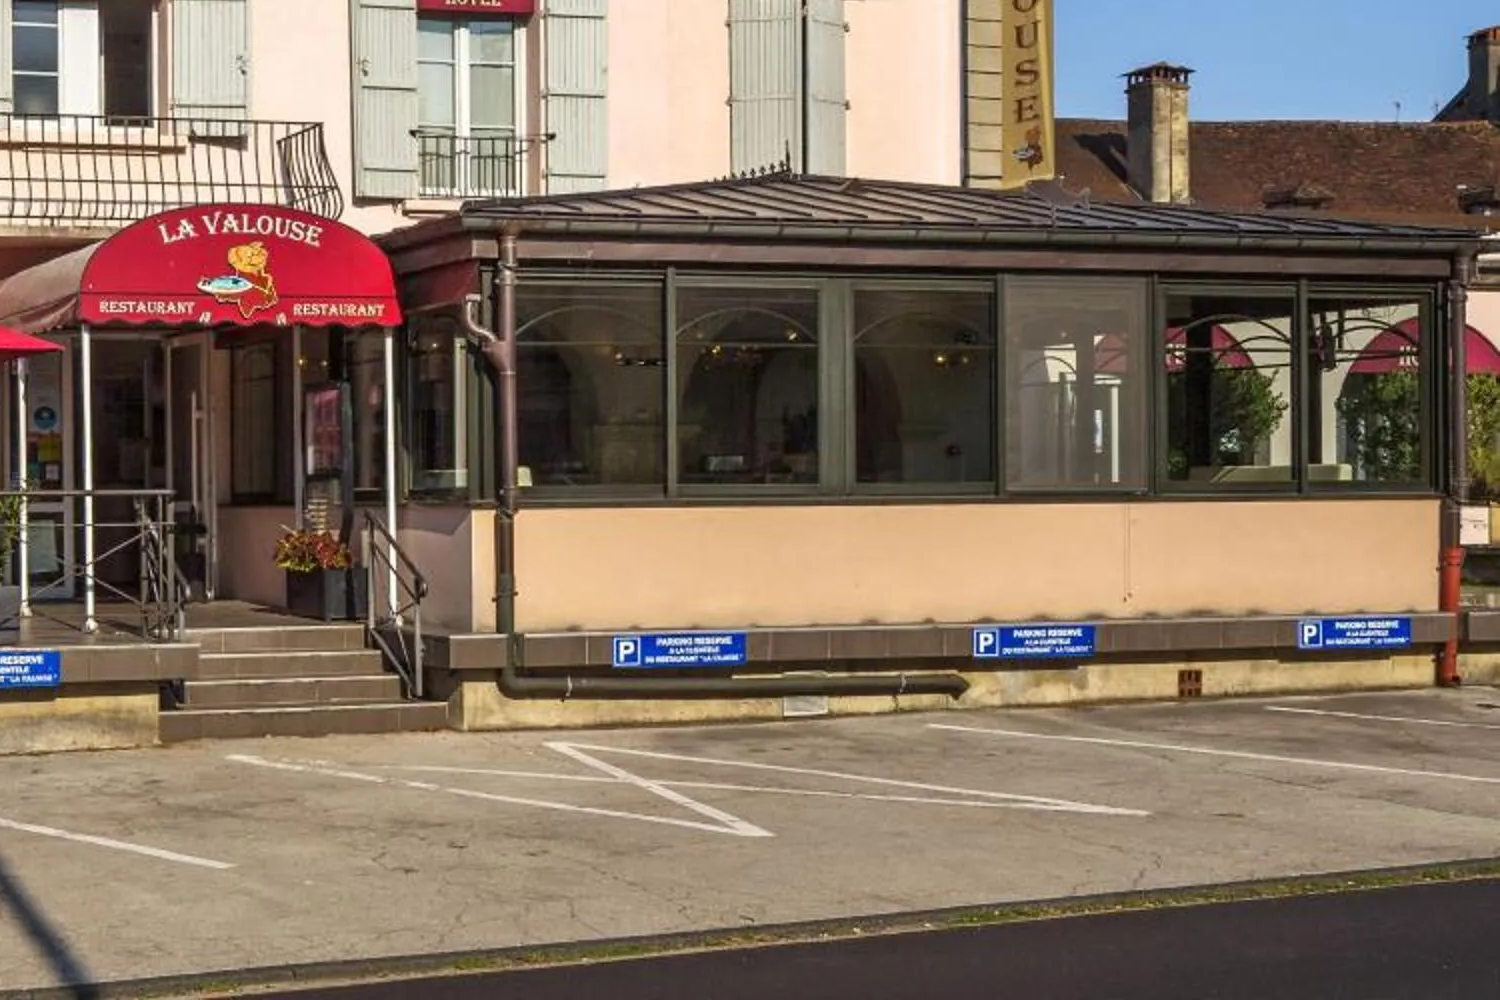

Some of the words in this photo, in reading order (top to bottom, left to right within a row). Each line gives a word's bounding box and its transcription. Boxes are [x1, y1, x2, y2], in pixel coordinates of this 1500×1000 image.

[158, 220, 199, 244] LA
[202, 211, 324, 248] VALOUSE
[100, 301, 195, 316] RESTAURANT
[293, 303, 385, 318] RESTAURANT
[979, 633, 994, 653] P
[1303, 625, 1317, 644] P
[619, 641, 635, 662] P
